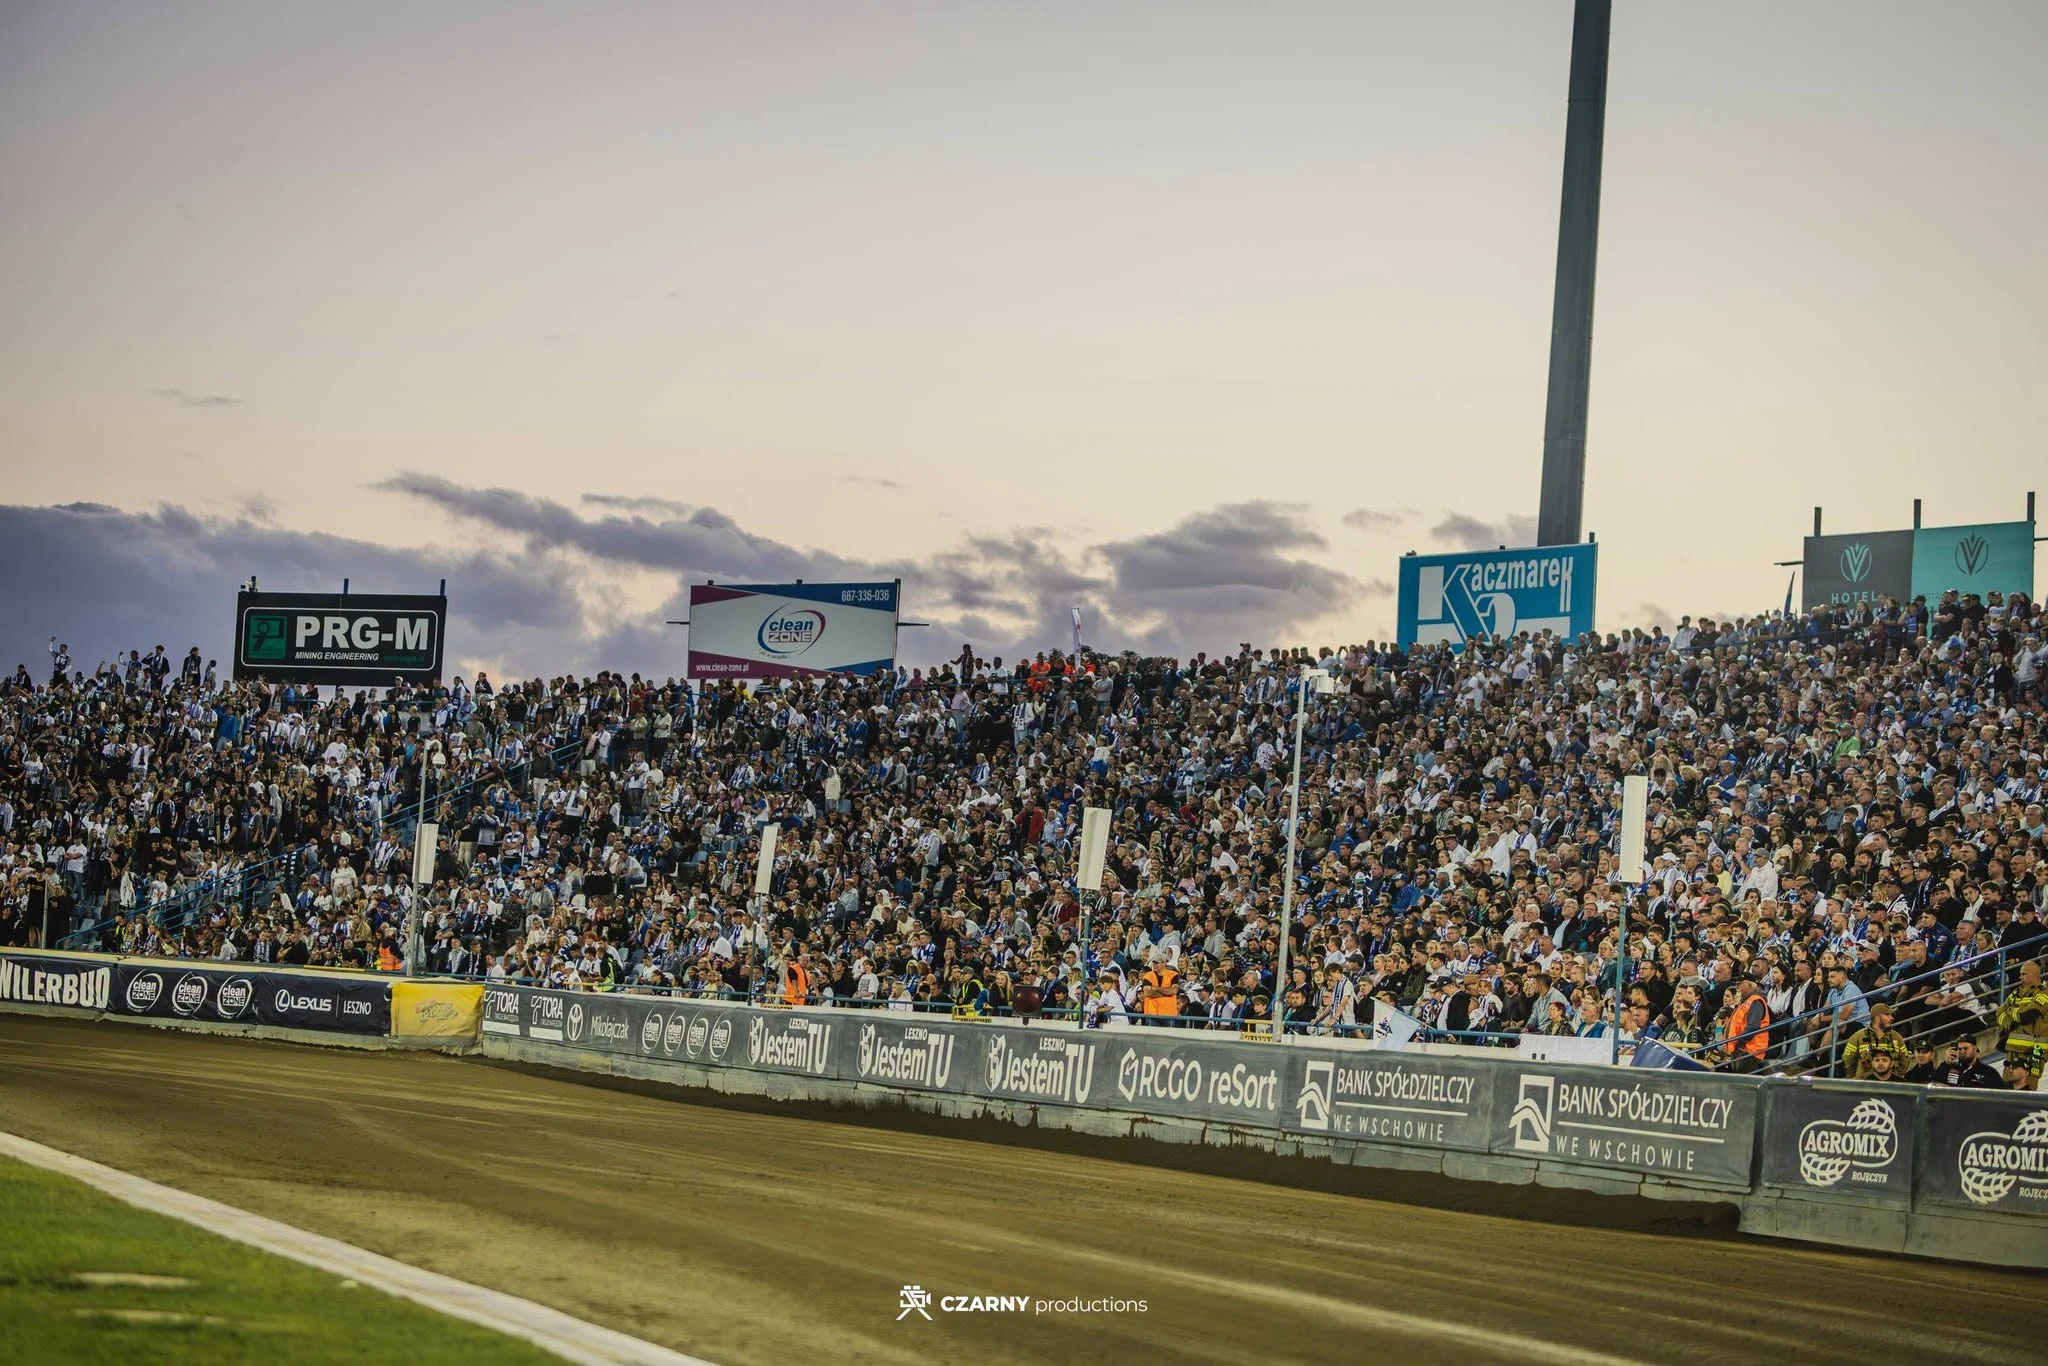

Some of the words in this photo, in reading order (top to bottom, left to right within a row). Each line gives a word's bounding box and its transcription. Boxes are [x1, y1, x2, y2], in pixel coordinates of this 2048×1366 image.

[1831, 591, 1878, 604] HOTEL
[769, 617, 814, 631] clean
[295, 615, 429, 650] PRG-M
[768, 631, 812, 643] ZONE
[295, 651, 323, 660] MINING
[324, 652, 379, 660] ENGINEERING
[696, 662, 749, 672] www.clean-zone.pl
[133, 979, 157, 991] clean
[178, 981, 202, 994] clean
[222, 984, 246, 997] clean
[132, 990, 156, 1000] ZONE
[177, 992, 201, 1003] ZONE
[222, 996, 245, 1007] ZONE
[291, 996, 332, 1012] LEXUS
[343, 1000, 371, 1015] LESZNO
[496, 991, 519, 1014] TORA
[542, 997, 563, 1019] TORA
[789, 1018, 808, 1030] LESZNO
[904, 1027, 928, 1040] LESZNO
[1039, 1037, 1066, 1052] LESZNO
[1208, 1063, 1277, 1110] reSort
[1336, 1068, 1373, 1096] BANK
[1374, 1065, 1475, 1104] SPÓŁDZIELCZY
[1559, 1084, 1604, 1116] BANK
[1607, 1083, 1734, 1130] SPÓŁDZIELCZY
[1333, 1114, 1351, 1133] WE
[1359, 1116, 1444, 1142] WSCHOWIE
[1804, 1129, 1890, 1159] AGROMIX
[1556, 1135, 1579, 1156] WE
[1589, 1138, 1695, 1171] WSCHOWIE
[1964, 1142, 2048, 1172] AGROMI
